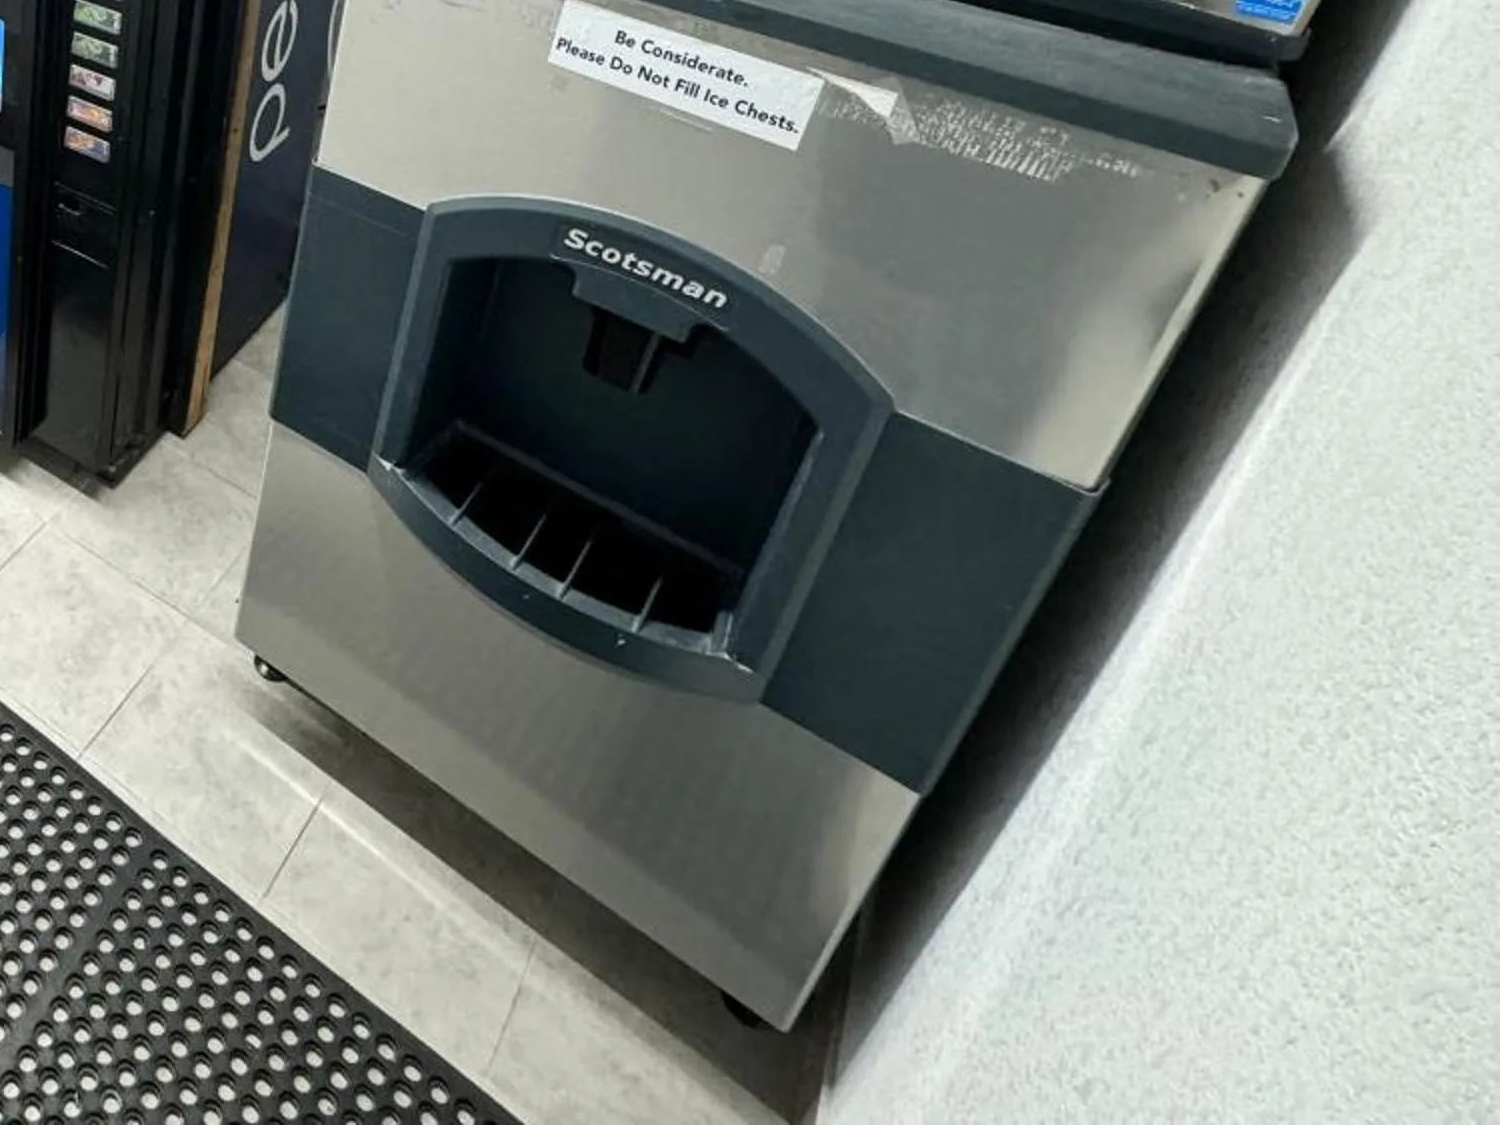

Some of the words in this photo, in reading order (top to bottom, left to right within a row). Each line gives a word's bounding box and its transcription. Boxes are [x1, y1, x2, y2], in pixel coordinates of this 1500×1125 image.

[555, 37, 605, 66] Please
[609, 56, 634, 75] Do
[637, 66, 671, 89] Not
[674, 79, 700, 99] Fill
[703, 88, 730, 109] Ice
[734, 100, 799, 134] Chests.
[613, 30, 637, 48] Be
[641, 39, 749, 87] Considerate.
[563, 227, 729, 309] Scotsman
